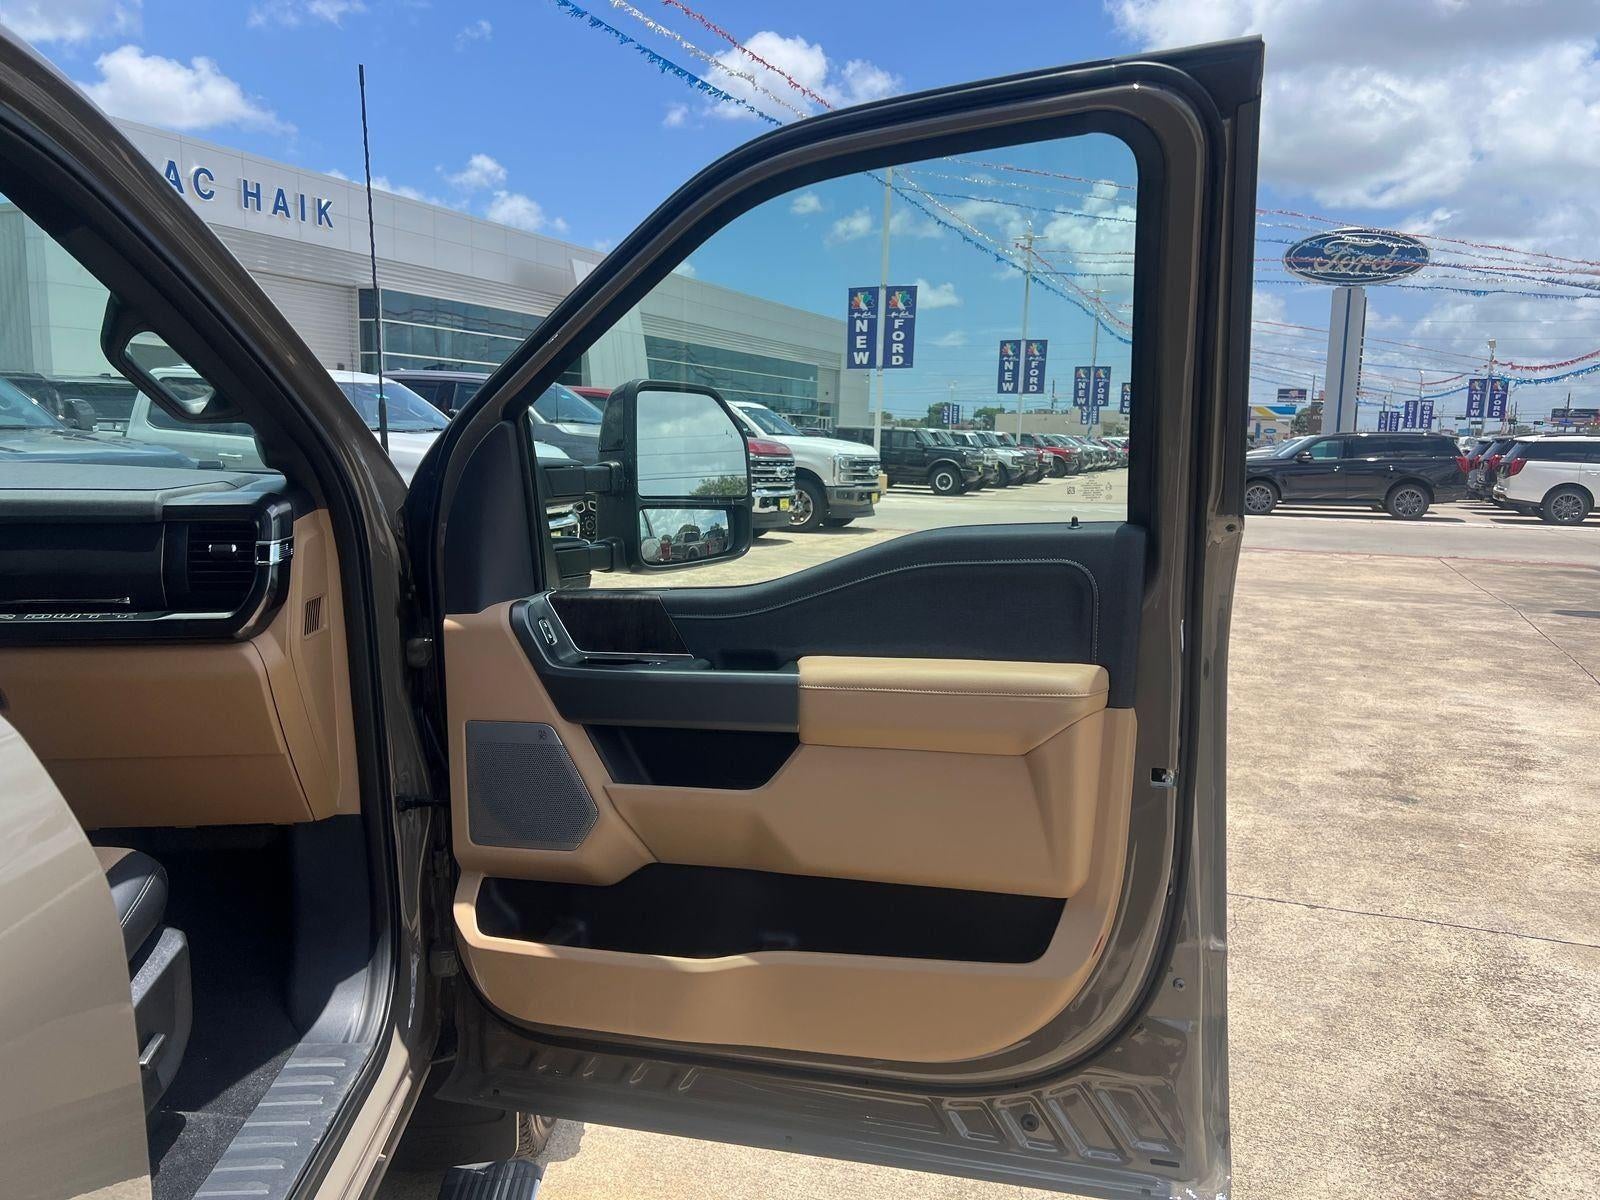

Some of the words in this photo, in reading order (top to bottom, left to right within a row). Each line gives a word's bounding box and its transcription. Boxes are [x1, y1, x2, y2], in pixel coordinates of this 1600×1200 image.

[242, 178, 334, 229] HAIK
[1313, 240, 1399, 273] Ford
[853, 319, 870, 365] NEW
[891, 319, 905, 366] FORD
[1002, 361, 1014, 392] NEW
[1029, 361, 1039, 392] FORD
[1077, 382, 1086, 405] NEW
[1097, 382, 1105, 405] FORD
[1470, 394, 1480, 416] NEW
[1492, 394, 1502, 417] FORD
[1422, 406, 1430, 428] OWNED
